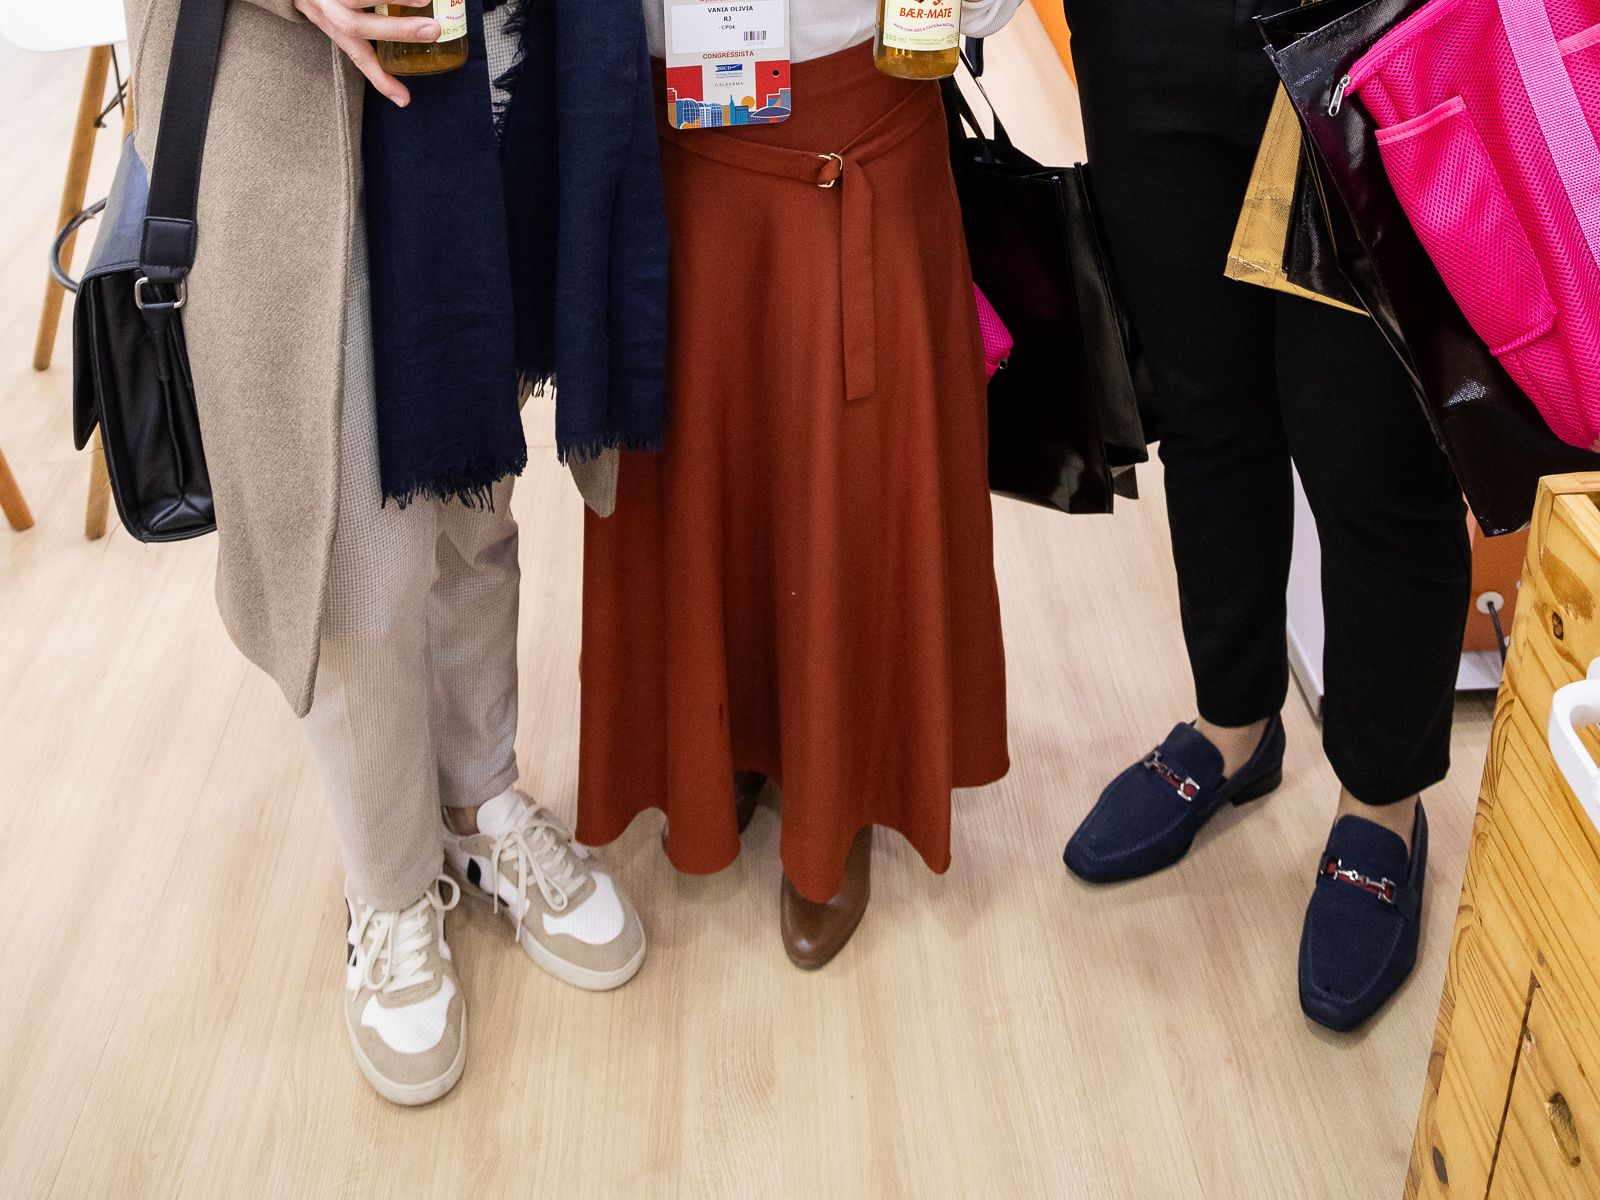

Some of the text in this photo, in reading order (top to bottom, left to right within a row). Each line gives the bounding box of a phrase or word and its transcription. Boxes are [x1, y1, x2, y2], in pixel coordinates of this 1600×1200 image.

[707, 5, 754, 13] VANIA OLIVIA
[899, 7, 953, 19] BÆR-MATE
[702, 50, 755, 60] CONGRESSISTA
